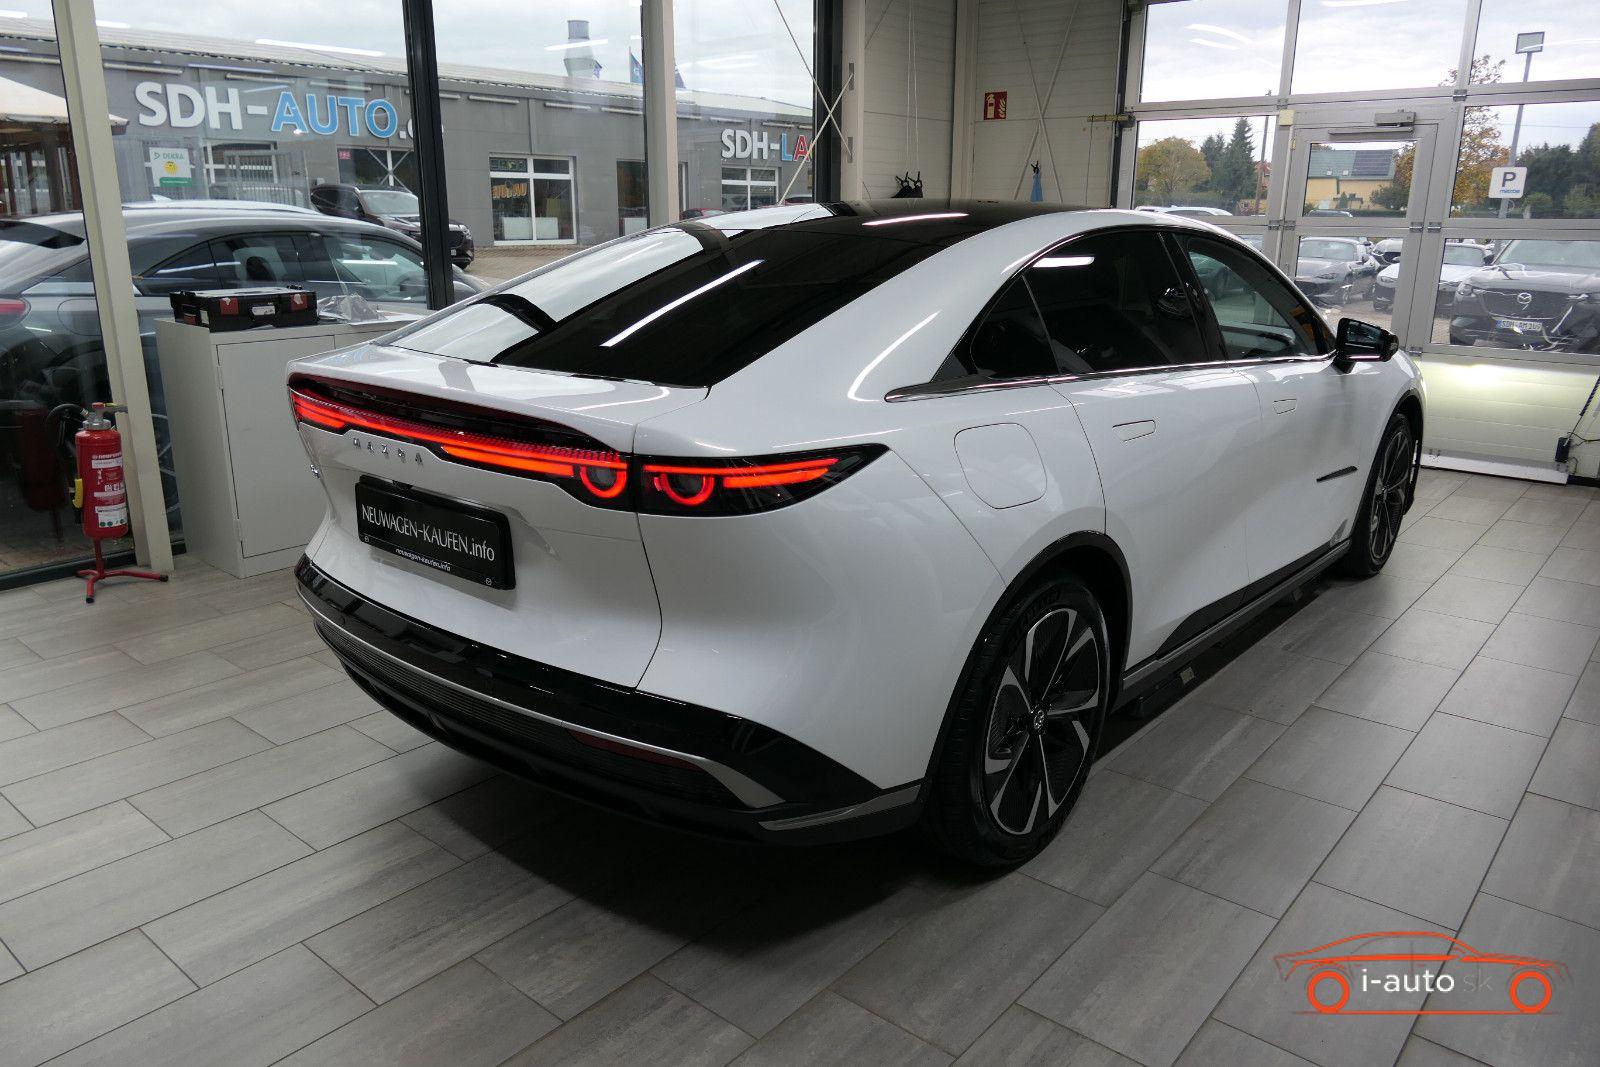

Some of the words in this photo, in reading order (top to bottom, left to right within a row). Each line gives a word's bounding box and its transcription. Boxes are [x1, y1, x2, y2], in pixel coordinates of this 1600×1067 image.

[134, 81, 443, 139] SDH-AUTO.
[721, 128, 813, 162] SDH-LA
[1502, 171, 1517, 188] P
[361, 503, 495, 561] NEUWAGEN-KAUFEN.info
